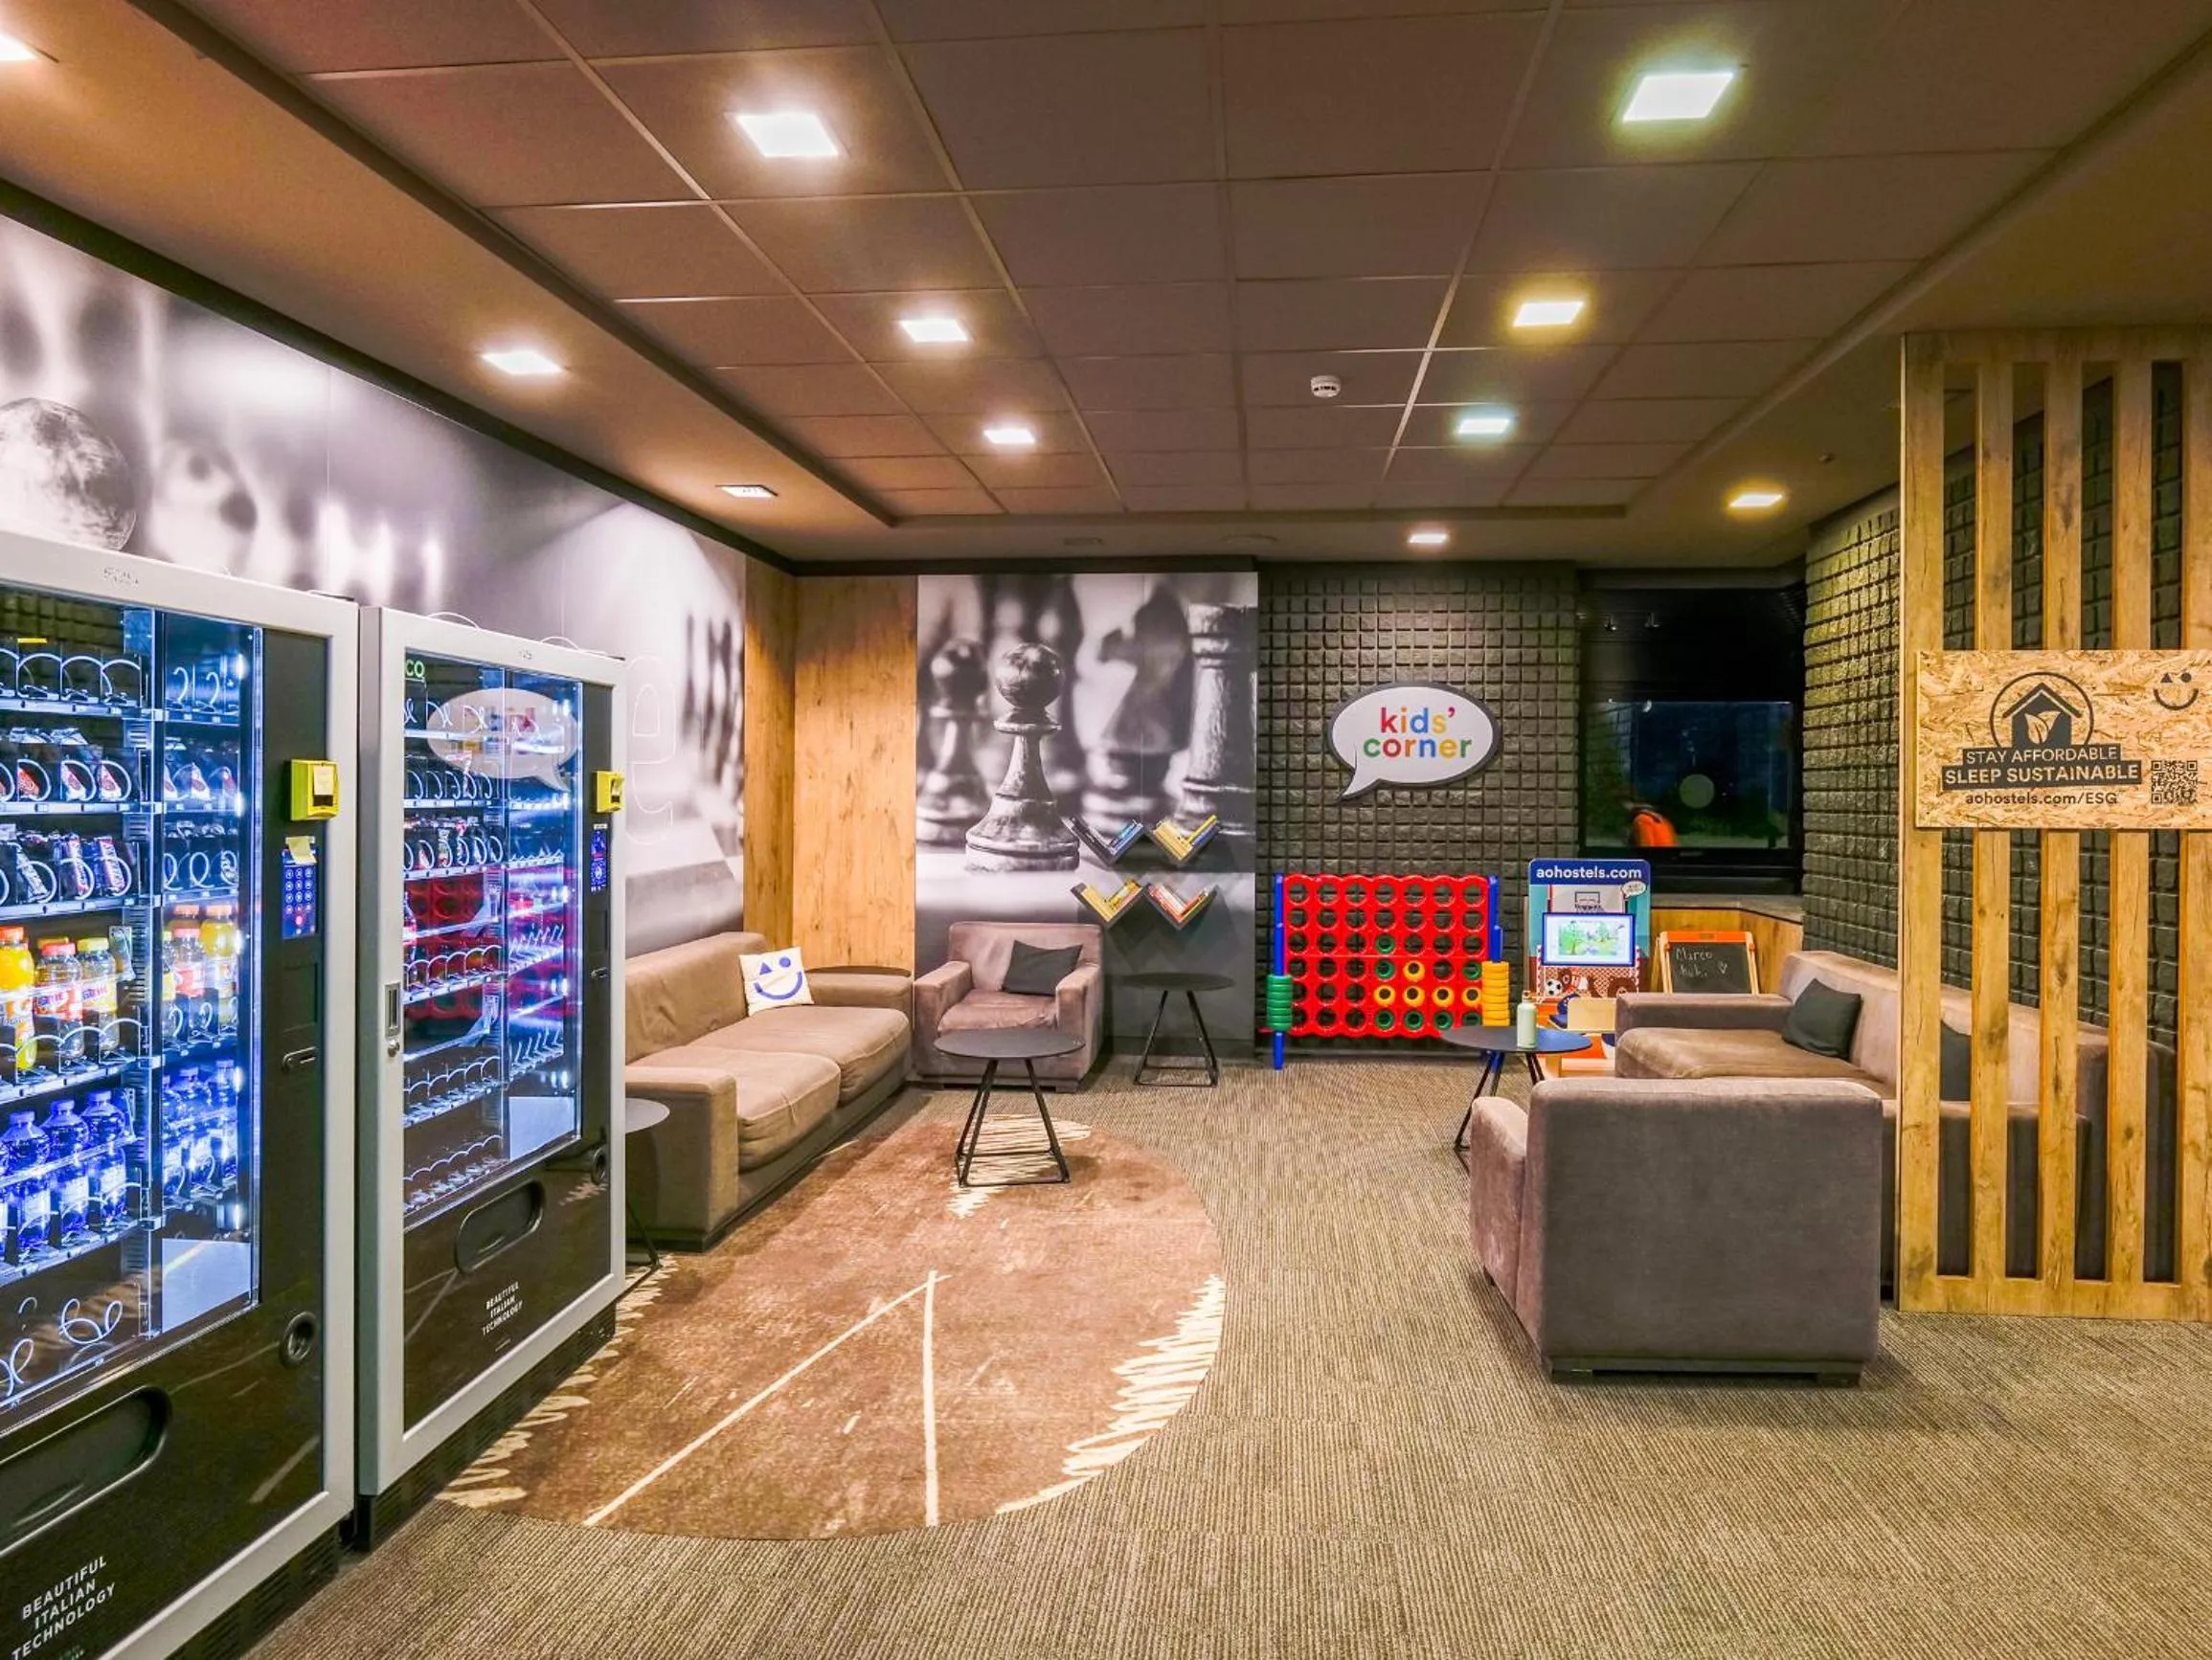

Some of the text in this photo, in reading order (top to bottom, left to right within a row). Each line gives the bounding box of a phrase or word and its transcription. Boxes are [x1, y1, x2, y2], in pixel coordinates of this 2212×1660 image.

[1363, 738, 1472, 758] corner
[1966, 747, 2118, 764] STAY AFFORDABLE
[1945, 764, 2139, 784] SLEEP SUSTAINABLE
[1965, 790, 2118, 805] aohostels.com/ESG
[1536, 865, 1642, 879] aohostels.com
[22, 1556, 107, 1620] BEAUTIFUL
[34, 1579, 96, 1629] ITALIAN
[11, 1582, 115, 1660] TECHNOLOGY
